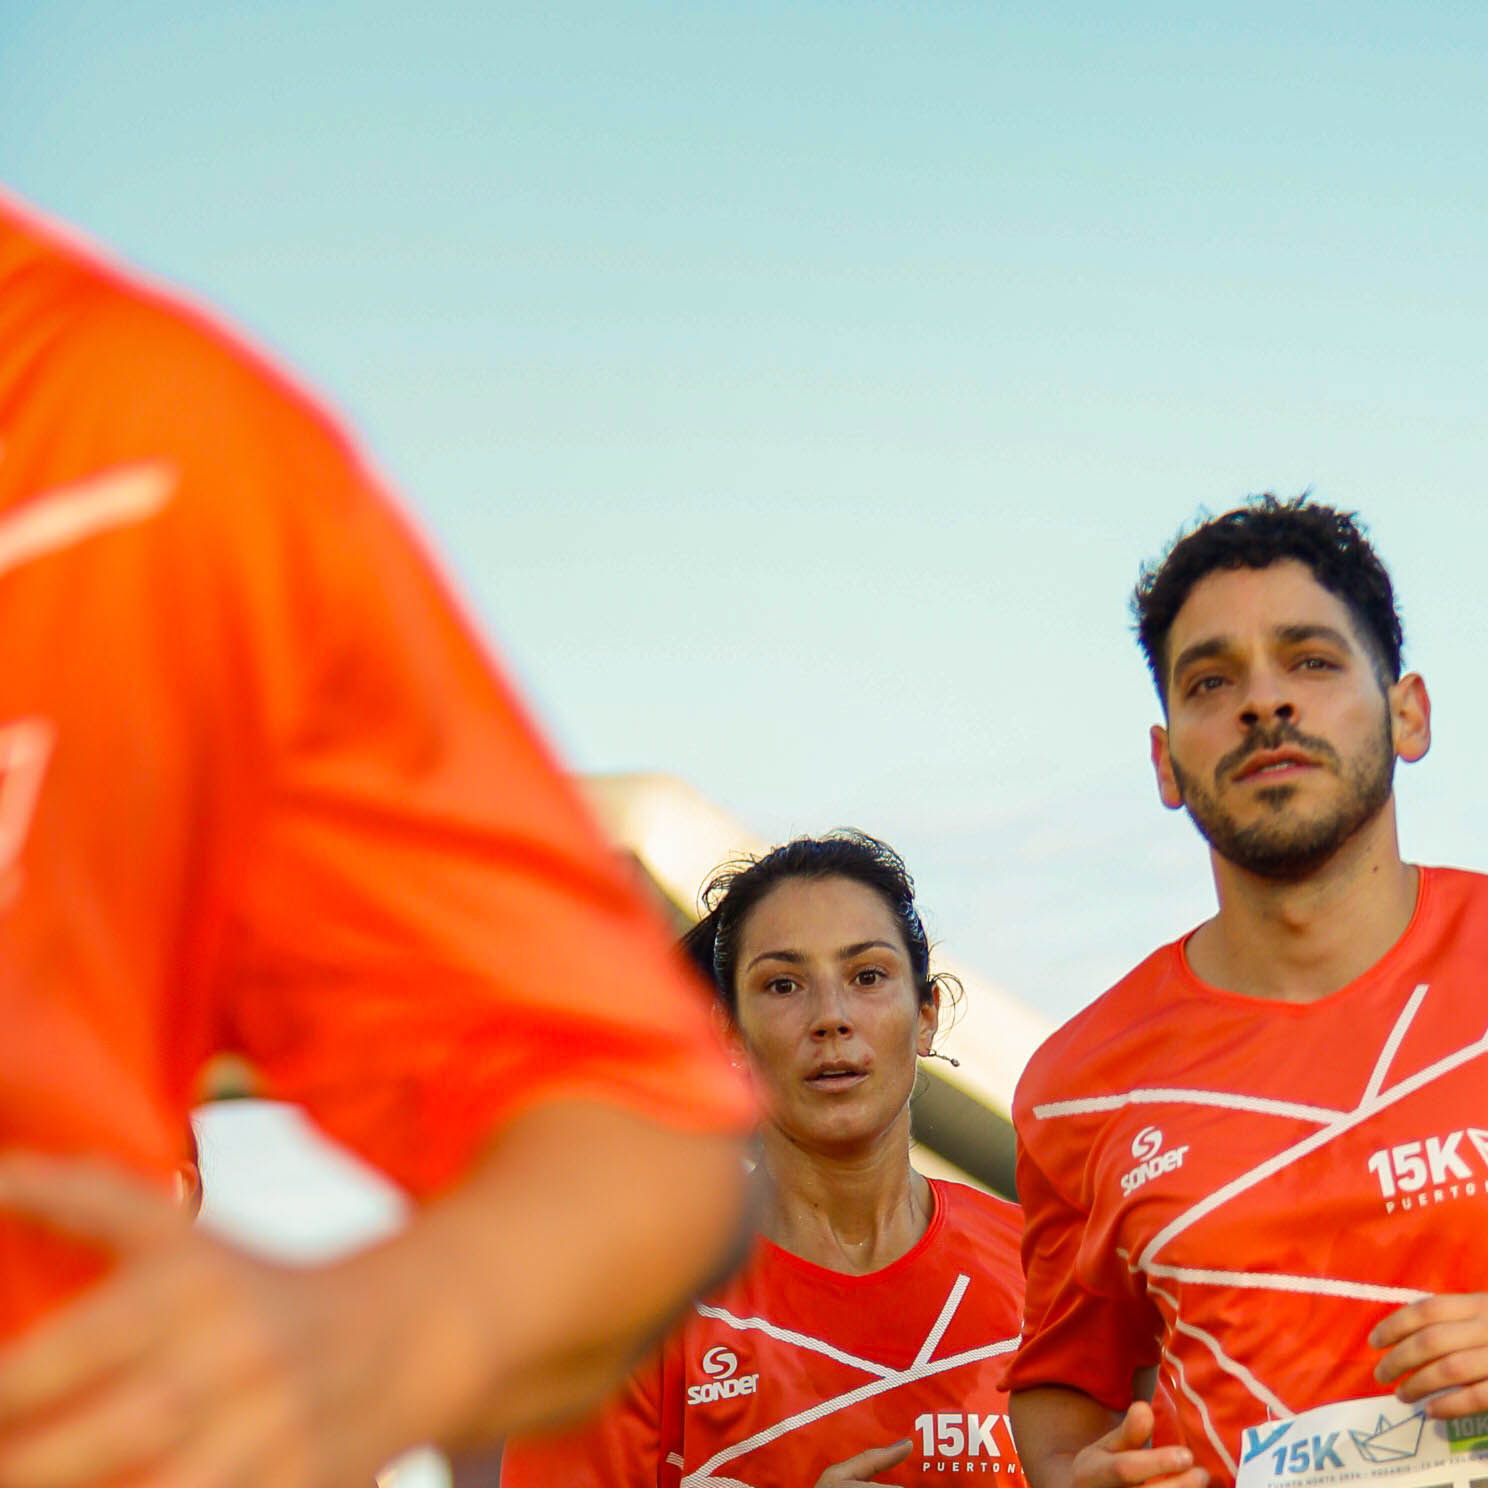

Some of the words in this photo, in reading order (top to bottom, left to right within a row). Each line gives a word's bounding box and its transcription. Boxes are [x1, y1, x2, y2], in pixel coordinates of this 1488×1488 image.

[1368, 1130, 1473, 1199] 15K
[1386, 1185, 1476, 1214] PUERTO
[915, 1413, 1001, 1457] 15K
[1272, 1429, 1345, 1476] 15K
[922, 1462, 1000, 1473] PUERTO
